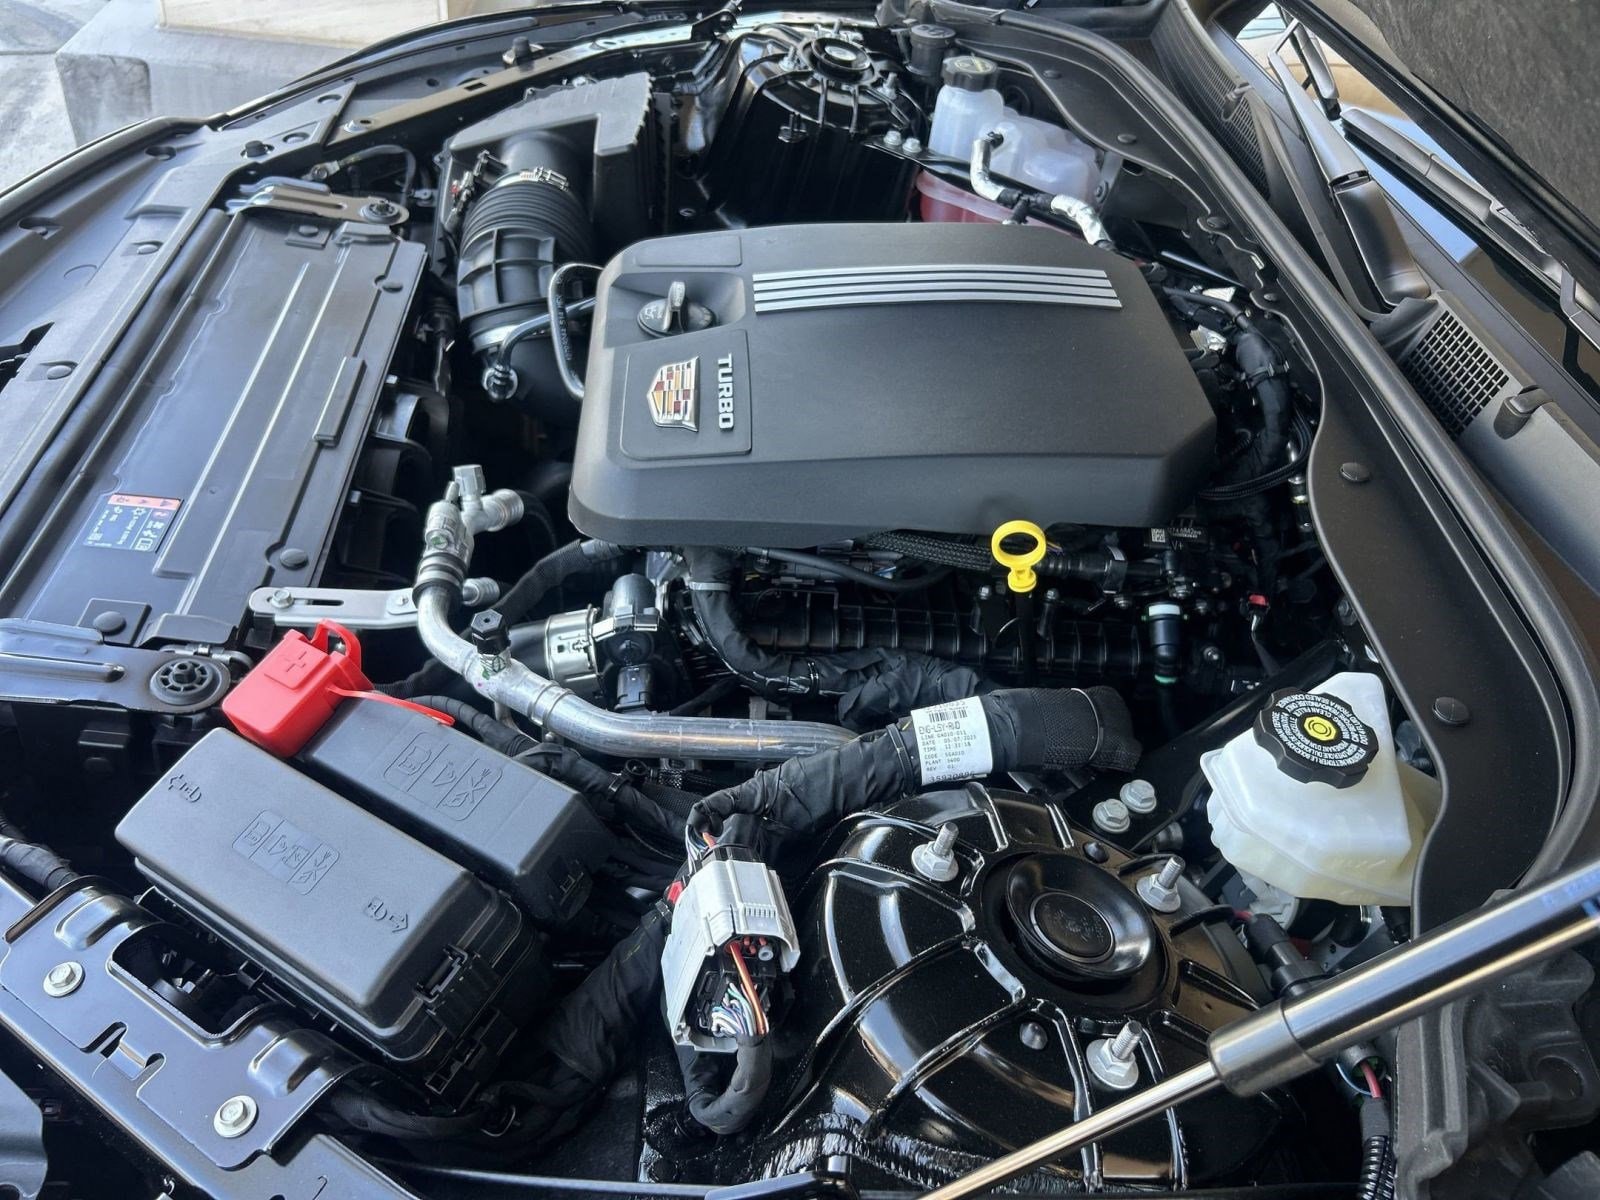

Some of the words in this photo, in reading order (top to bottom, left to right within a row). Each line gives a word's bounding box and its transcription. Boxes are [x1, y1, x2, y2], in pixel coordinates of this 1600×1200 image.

[718, 353, 734, 430] TURBO
[1304, 694, 1329, 705] SEALED
[1310, 708, 1332, 718] CLEAN
[1333, 703, 1352, 717] FROM
[1348, 715, 1364, 730] FLUID
[1350, 733, 1358, 742] CAP
[1309, 755, 1318, 763] LE
